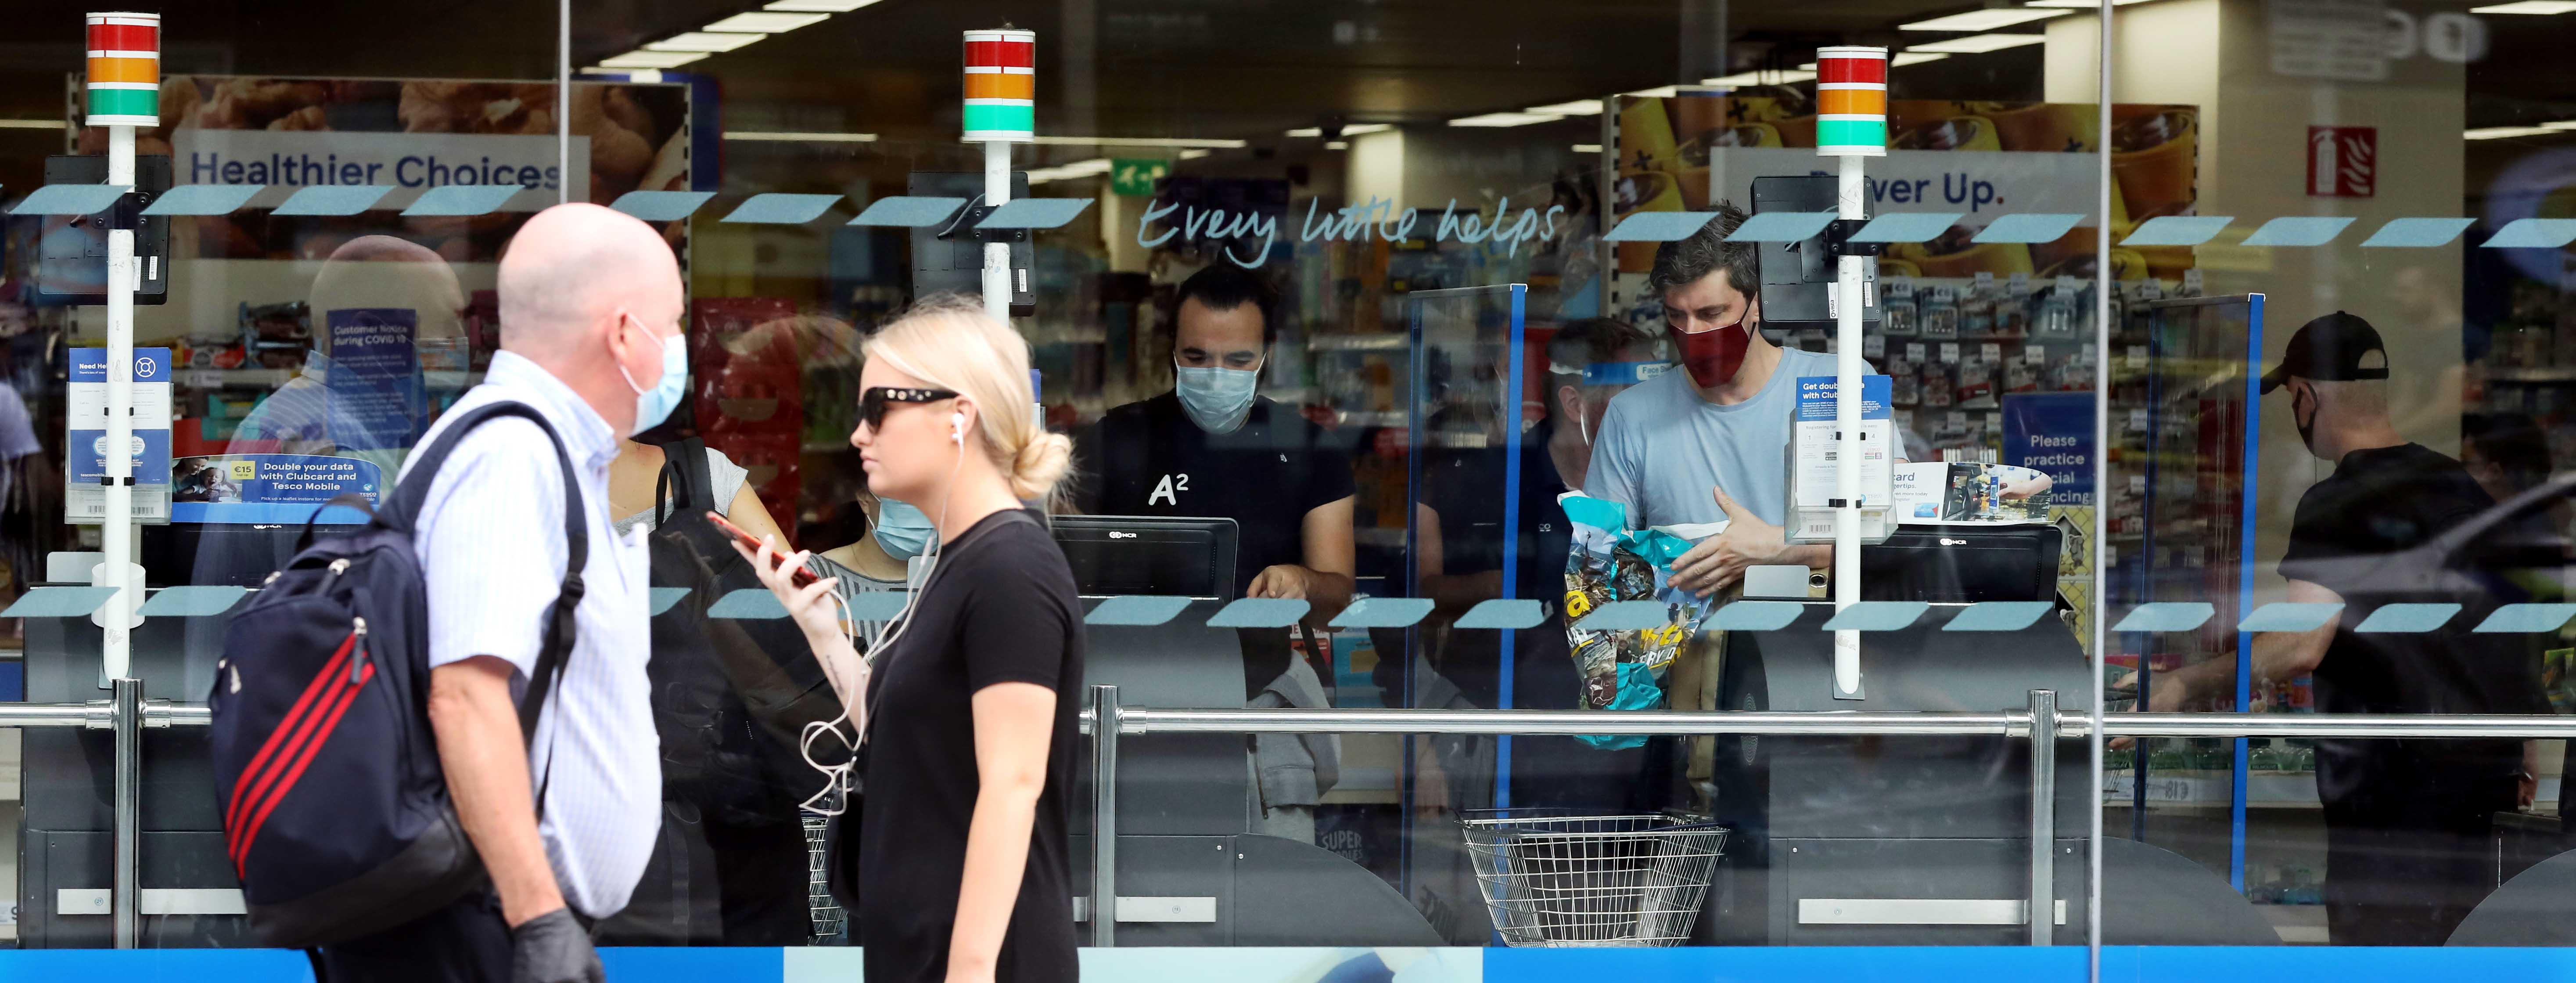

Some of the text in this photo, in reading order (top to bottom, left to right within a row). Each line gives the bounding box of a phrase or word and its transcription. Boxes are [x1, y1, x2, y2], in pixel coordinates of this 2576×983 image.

[190, 152, 559, 189] Healthier Choices
[1944, 173, 2004, 212] Up.
[1137, 195, 1565, 269] Every little helps
[334, 337, 363, 347] during
[365, 335, 395, 344] COVID
[2031, 435, 2077, 447] Please
[2024, 455, 2085, 468] practice
[304, 465, 328, 473] your
[2051, 471, 2075, 484] cial
[1321, 830, 1362, 850] SUPER
